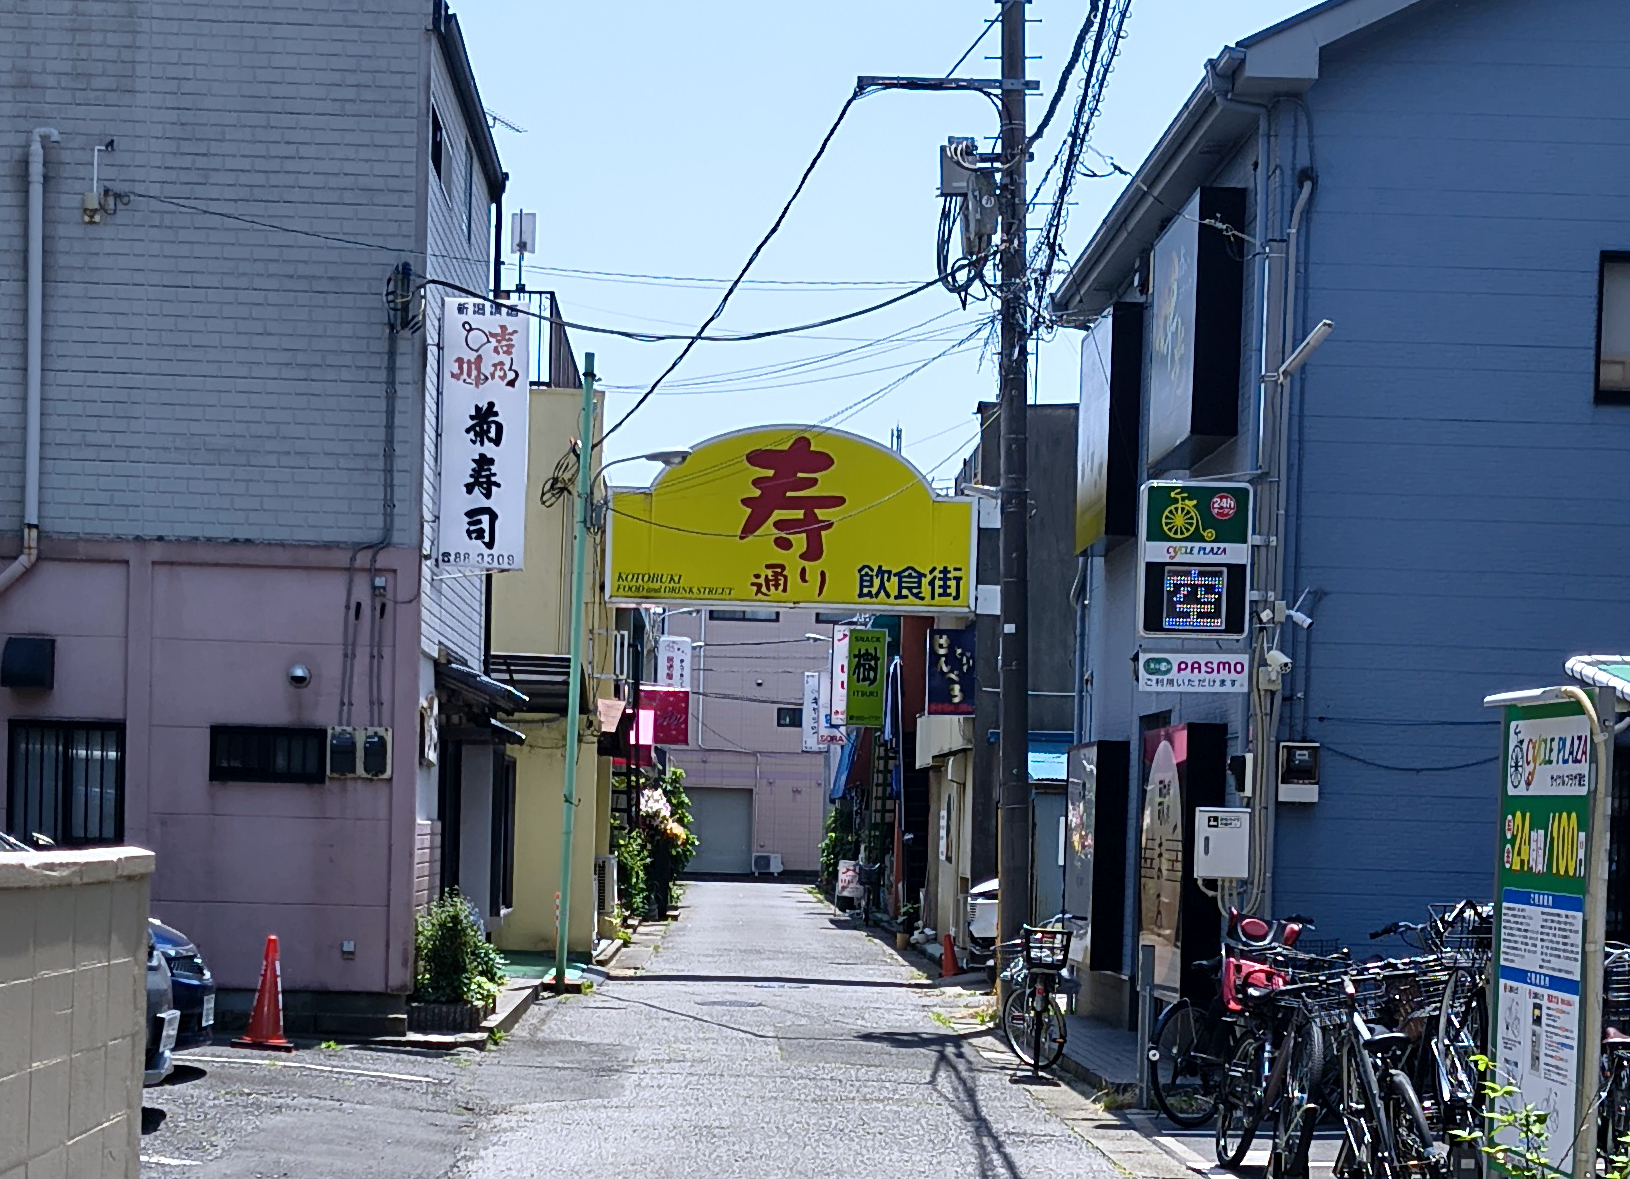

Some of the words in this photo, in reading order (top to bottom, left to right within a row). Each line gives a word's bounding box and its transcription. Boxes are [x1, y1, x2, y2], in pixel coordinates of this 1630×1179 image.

[464, 400, 504, 550] 菊寿司
[739, 436, 847, 562] 寿
[1212, 497, 1235, 509] 24h
[1197, 545, 1227, 556] PLAZA
[616, 572, 683, 585] KOTOBUKI
[750, 564, 827, 598] 通り
[857, 564, 963, 601] 飲食街
[616, 584, 645, 593] FOOD
[646, 584, 662, 594] and
[663, 585, 696, 595] DRINK
[696, 586, 735, 596] STREET
[854, 635, 881, 643] SNACK
[852, 646, 881, 687] 樹
[1177, 660, 1245, 675] PASMO
[853, 690, 879, 698] ITSUKI
[1556, 734, 1588, 765] PLAZA
